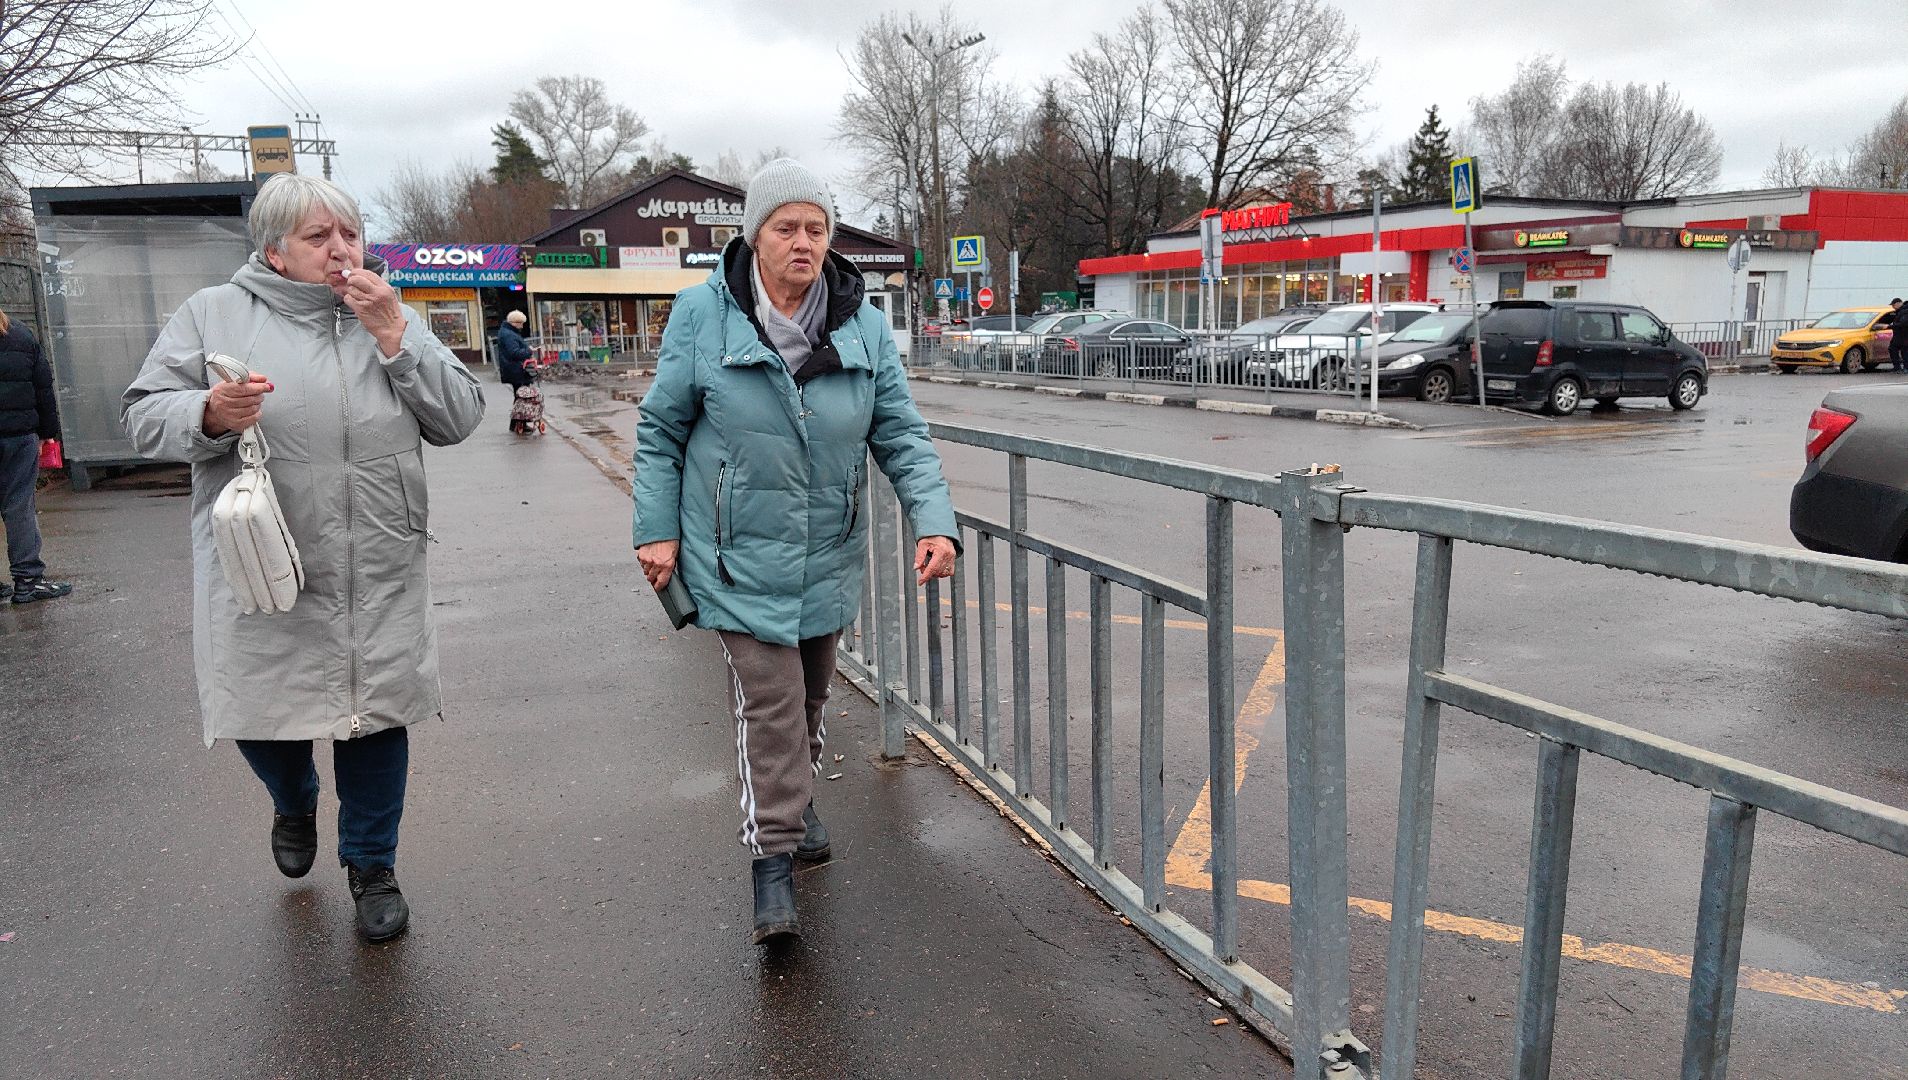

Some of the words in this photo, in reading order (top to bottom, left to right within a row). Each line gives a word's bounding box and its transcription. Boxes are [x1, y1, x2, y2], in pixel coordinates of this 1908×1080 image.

[637, 198, 743, 219] Марийка
[698, 216, 742, 224] ПРОДУКТЫ
[1201, 201, 1293, 232] МАГНИТ
[415, 247, 484, 265] OZON
[624, 247, 676, 258] ФРУКТЫ
[875, 254, 905, 263] КУХНЯ
[534, 253, 595, 266] АПТЕКА
[389, 270, 474, 284] Фермерская
